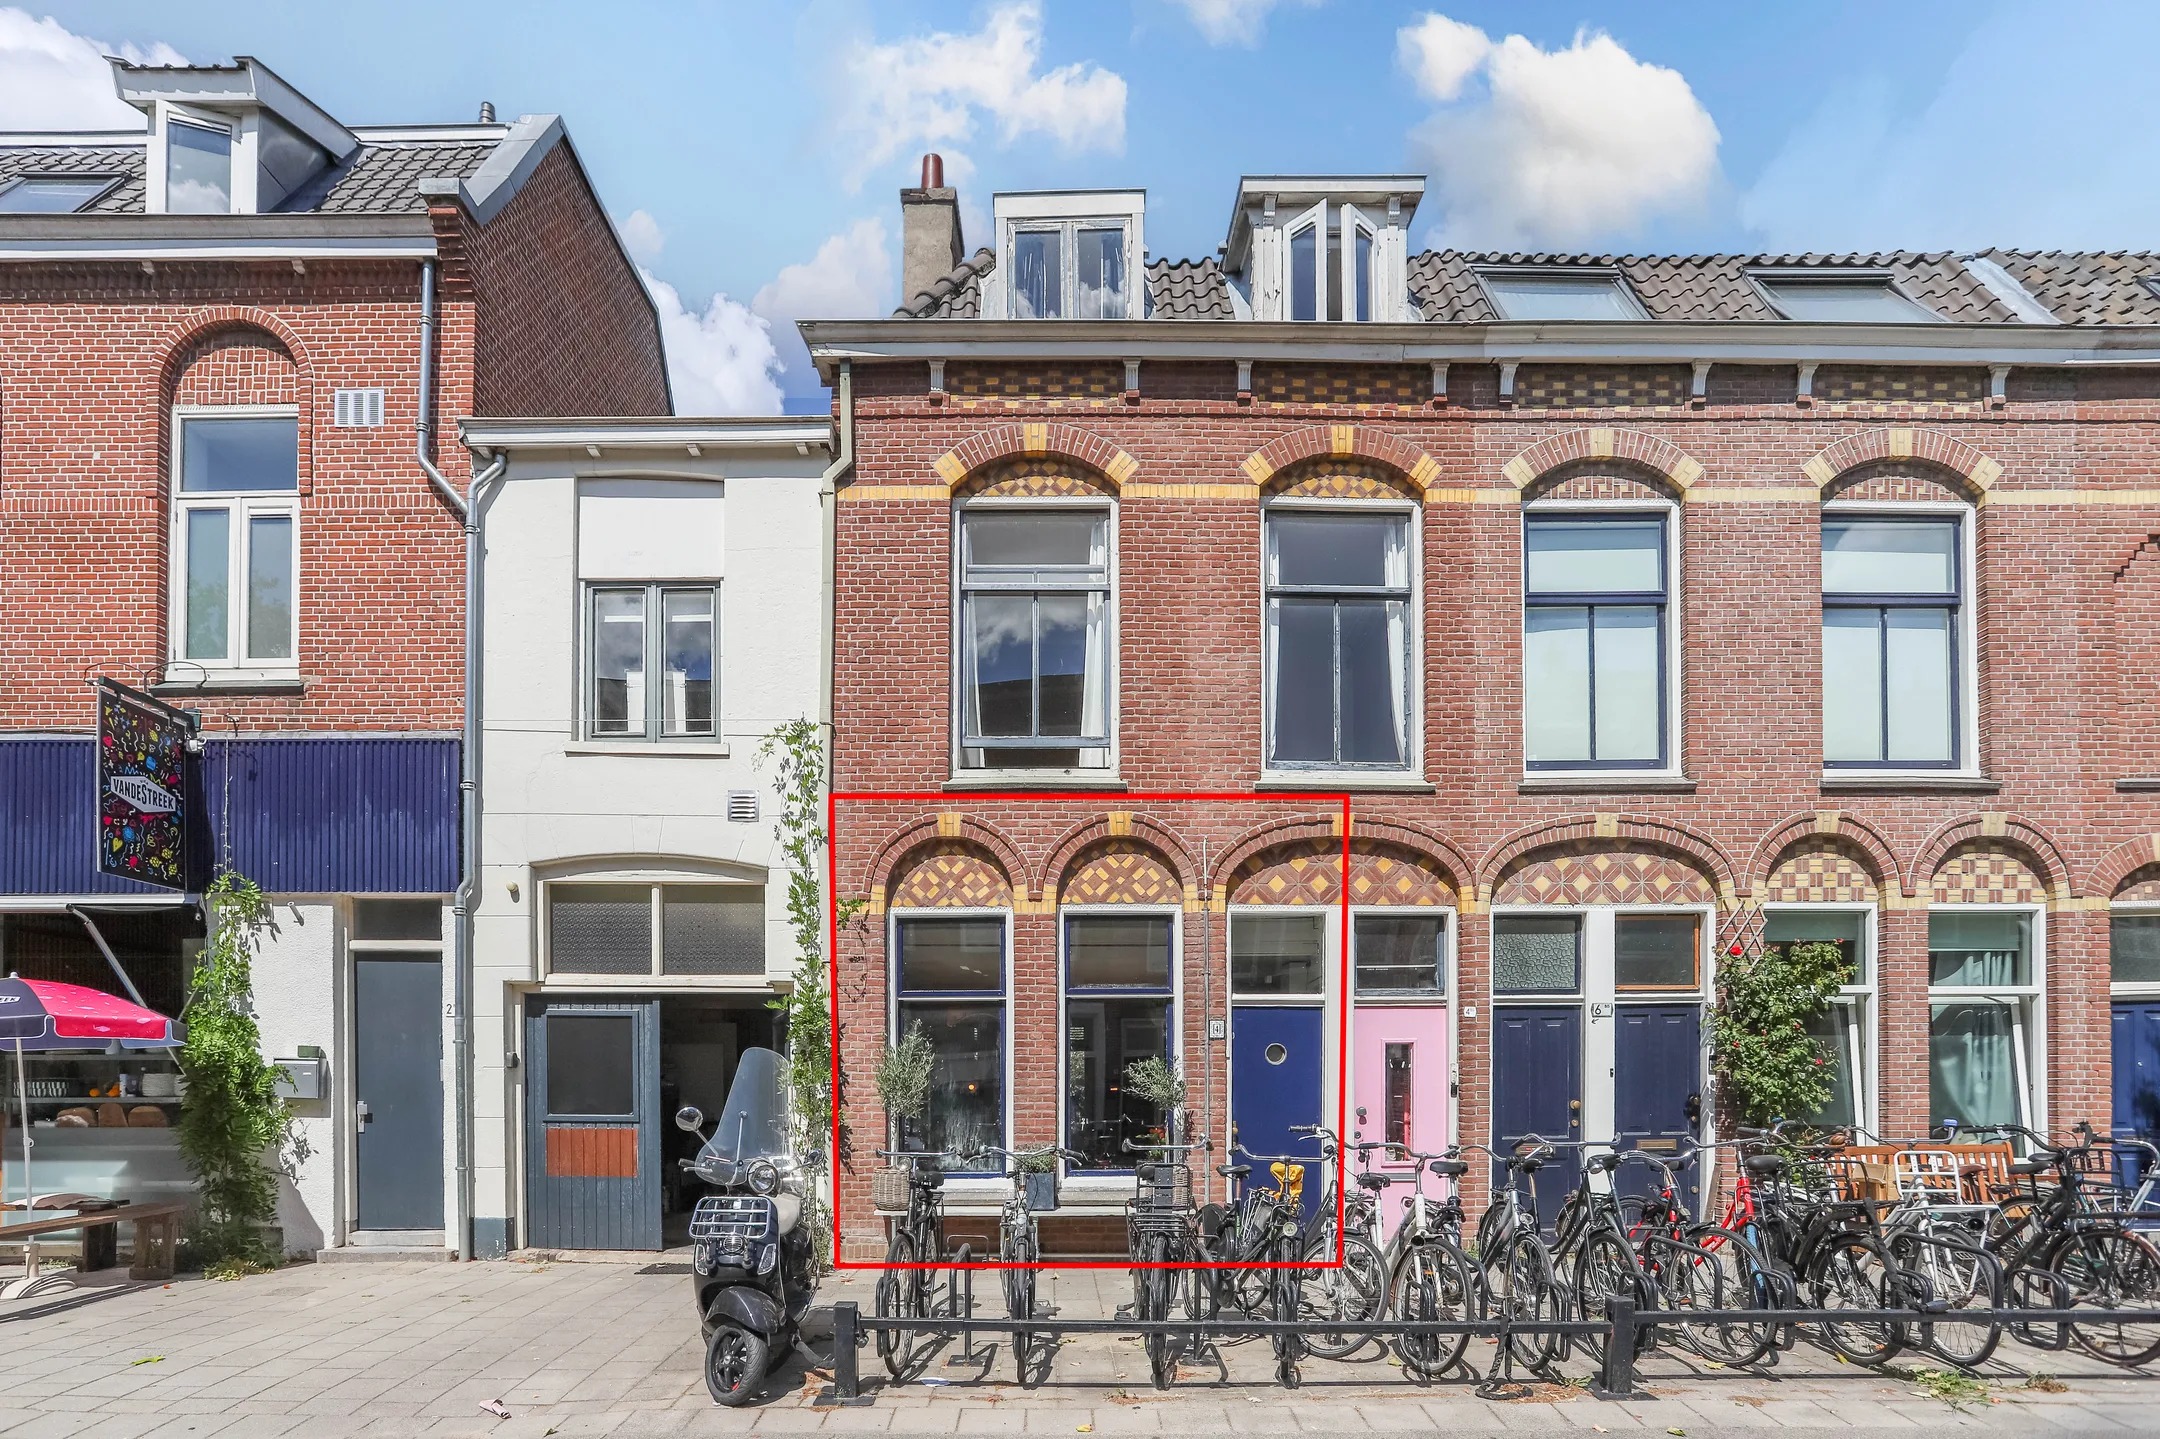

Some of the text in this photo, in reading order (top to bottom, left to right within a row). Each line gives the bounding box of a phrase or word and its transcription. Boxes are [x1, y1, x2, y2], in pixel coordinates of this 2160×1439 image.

[113, 779, 174, 809] VANDESTREEK
[446, 1003, 453, 1015] 2
[1594, 1004, 1602, 1015] 6
